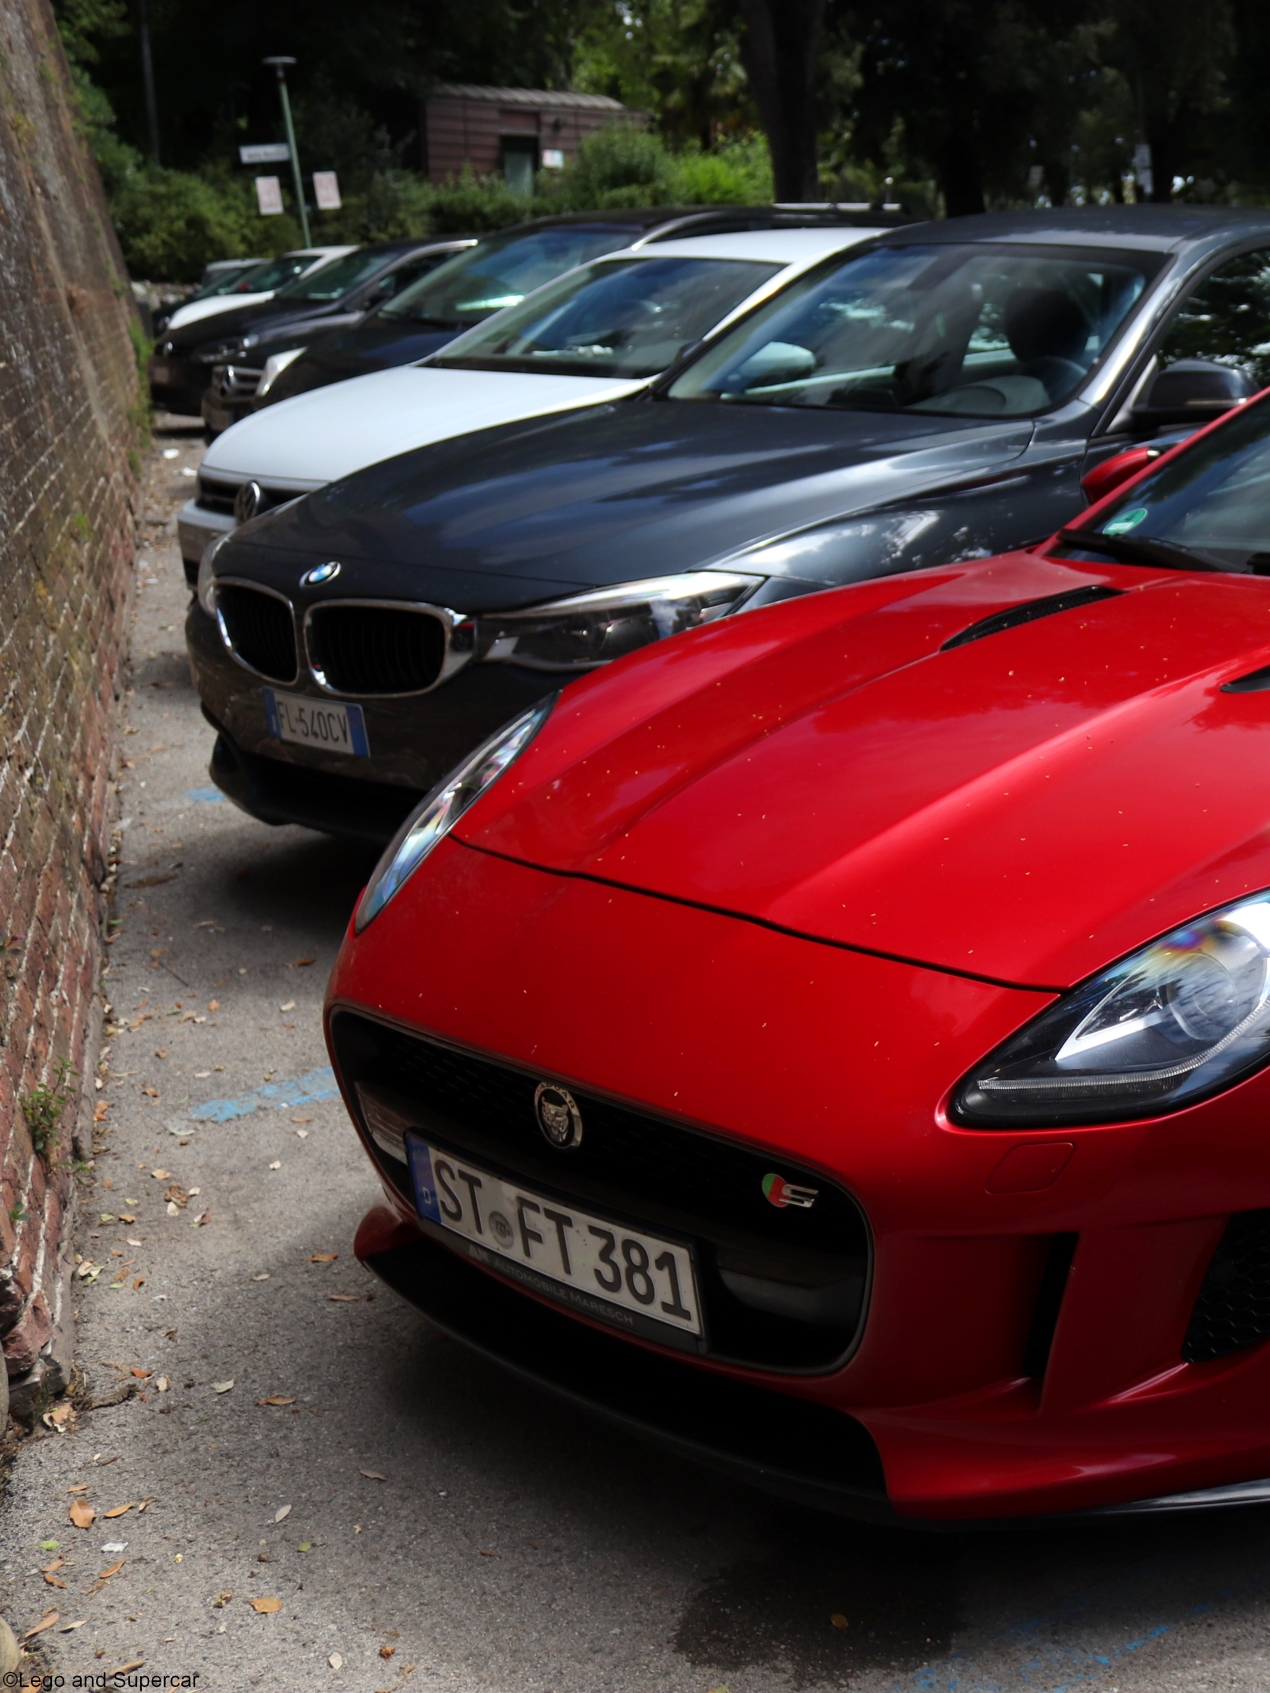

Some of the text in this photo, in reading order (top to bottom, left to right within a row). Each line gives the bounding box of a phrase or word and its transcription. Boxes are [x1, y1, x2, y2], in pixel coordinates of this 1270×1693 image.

[434, 1159, 692, 1322] ST FT 381
[570, 1291, 634, 1326] MARESCH
